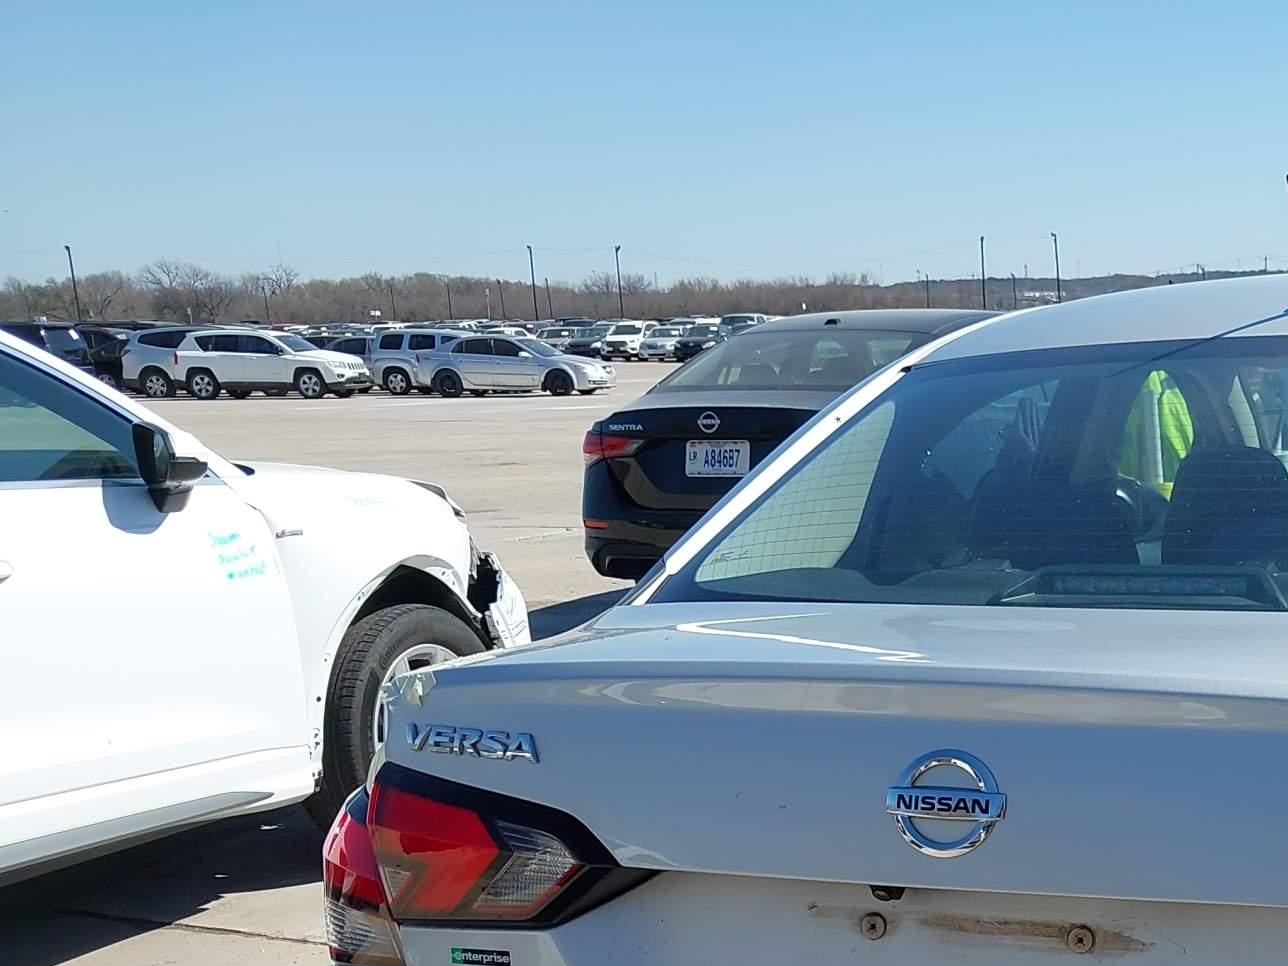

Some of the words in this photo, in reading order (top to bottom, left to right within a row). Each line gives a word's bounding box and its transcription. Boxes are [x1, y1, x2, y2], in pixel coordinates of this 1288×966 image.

[703, 449, 741, 468] A846B7
[405, 721, 540, 764] VERSA
[896, 793, 990, 815] NISSAN
[454, 951, 510, 963] enterprise
